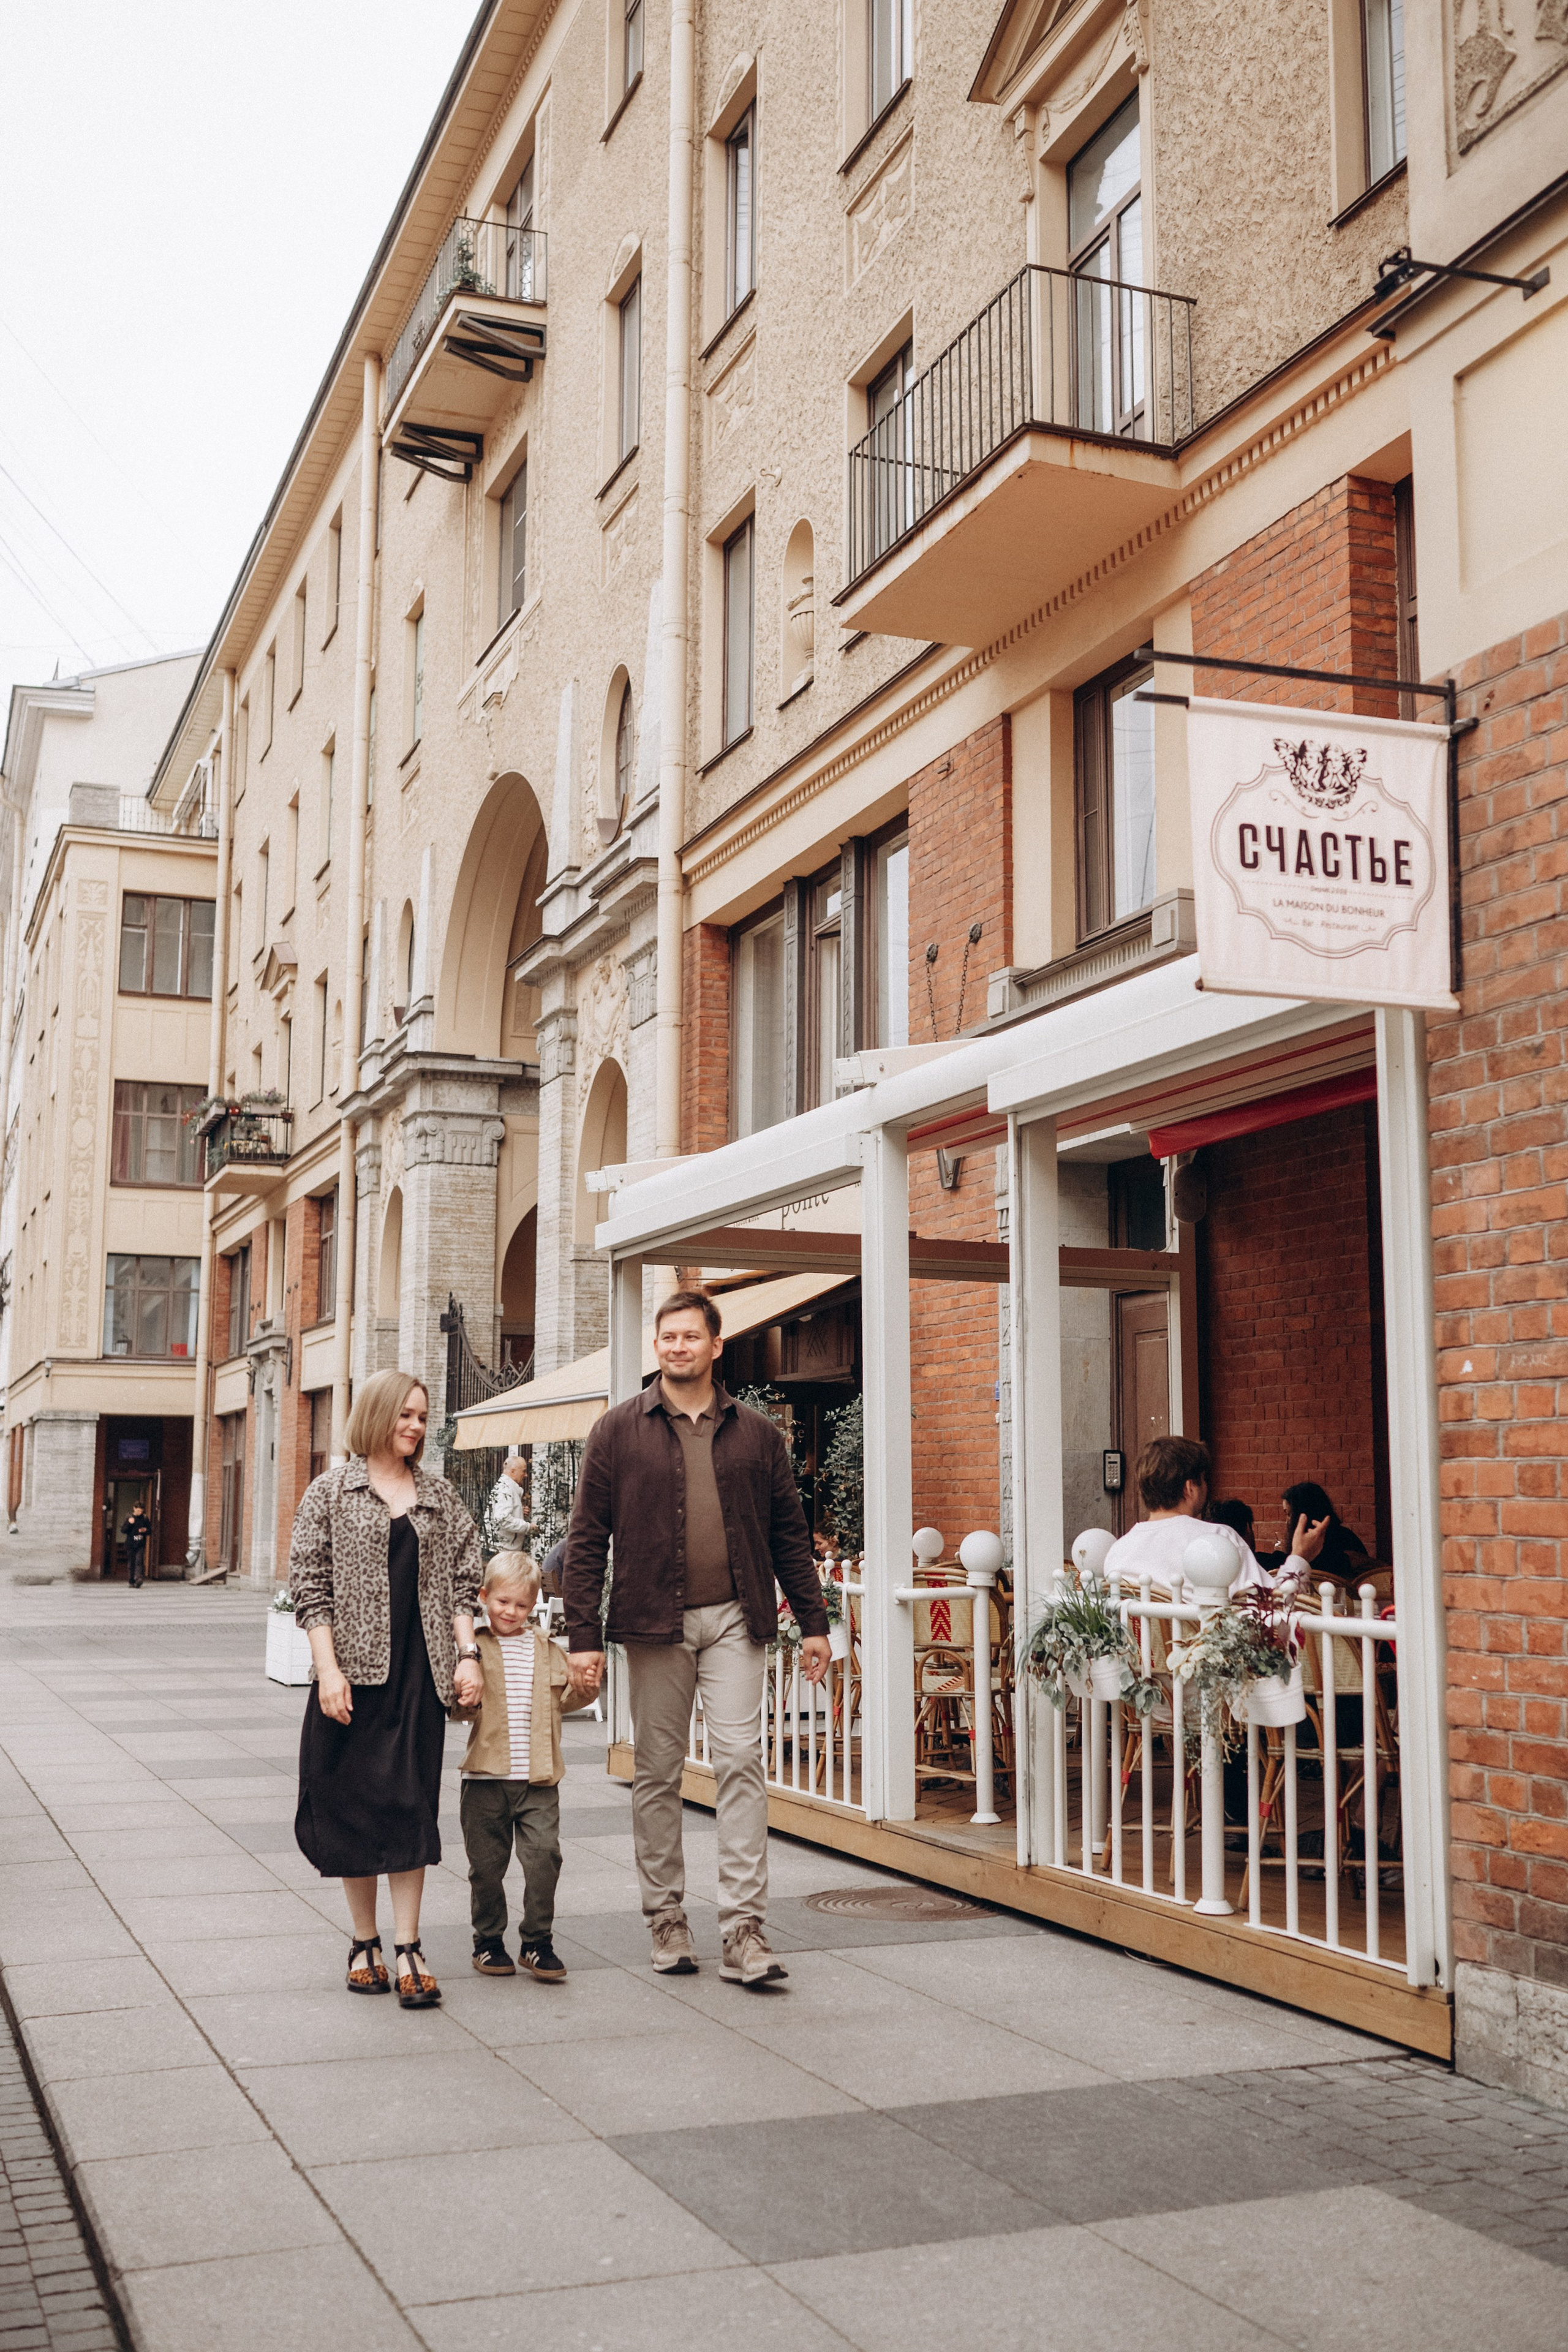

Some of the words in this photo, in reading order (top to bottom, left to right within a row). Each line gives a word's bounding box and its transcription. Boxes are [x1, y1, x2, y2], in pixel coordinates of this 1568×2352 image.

[1238, 823, 1413, 886] СЧАСТЬЕ
[1273, 898, 1284, 908] LA
[1286, 899, 1324, 911] MAISON
[1325, 903, 1340, 913] DU
[1341, 905, 1385, 918] BONHEUR
